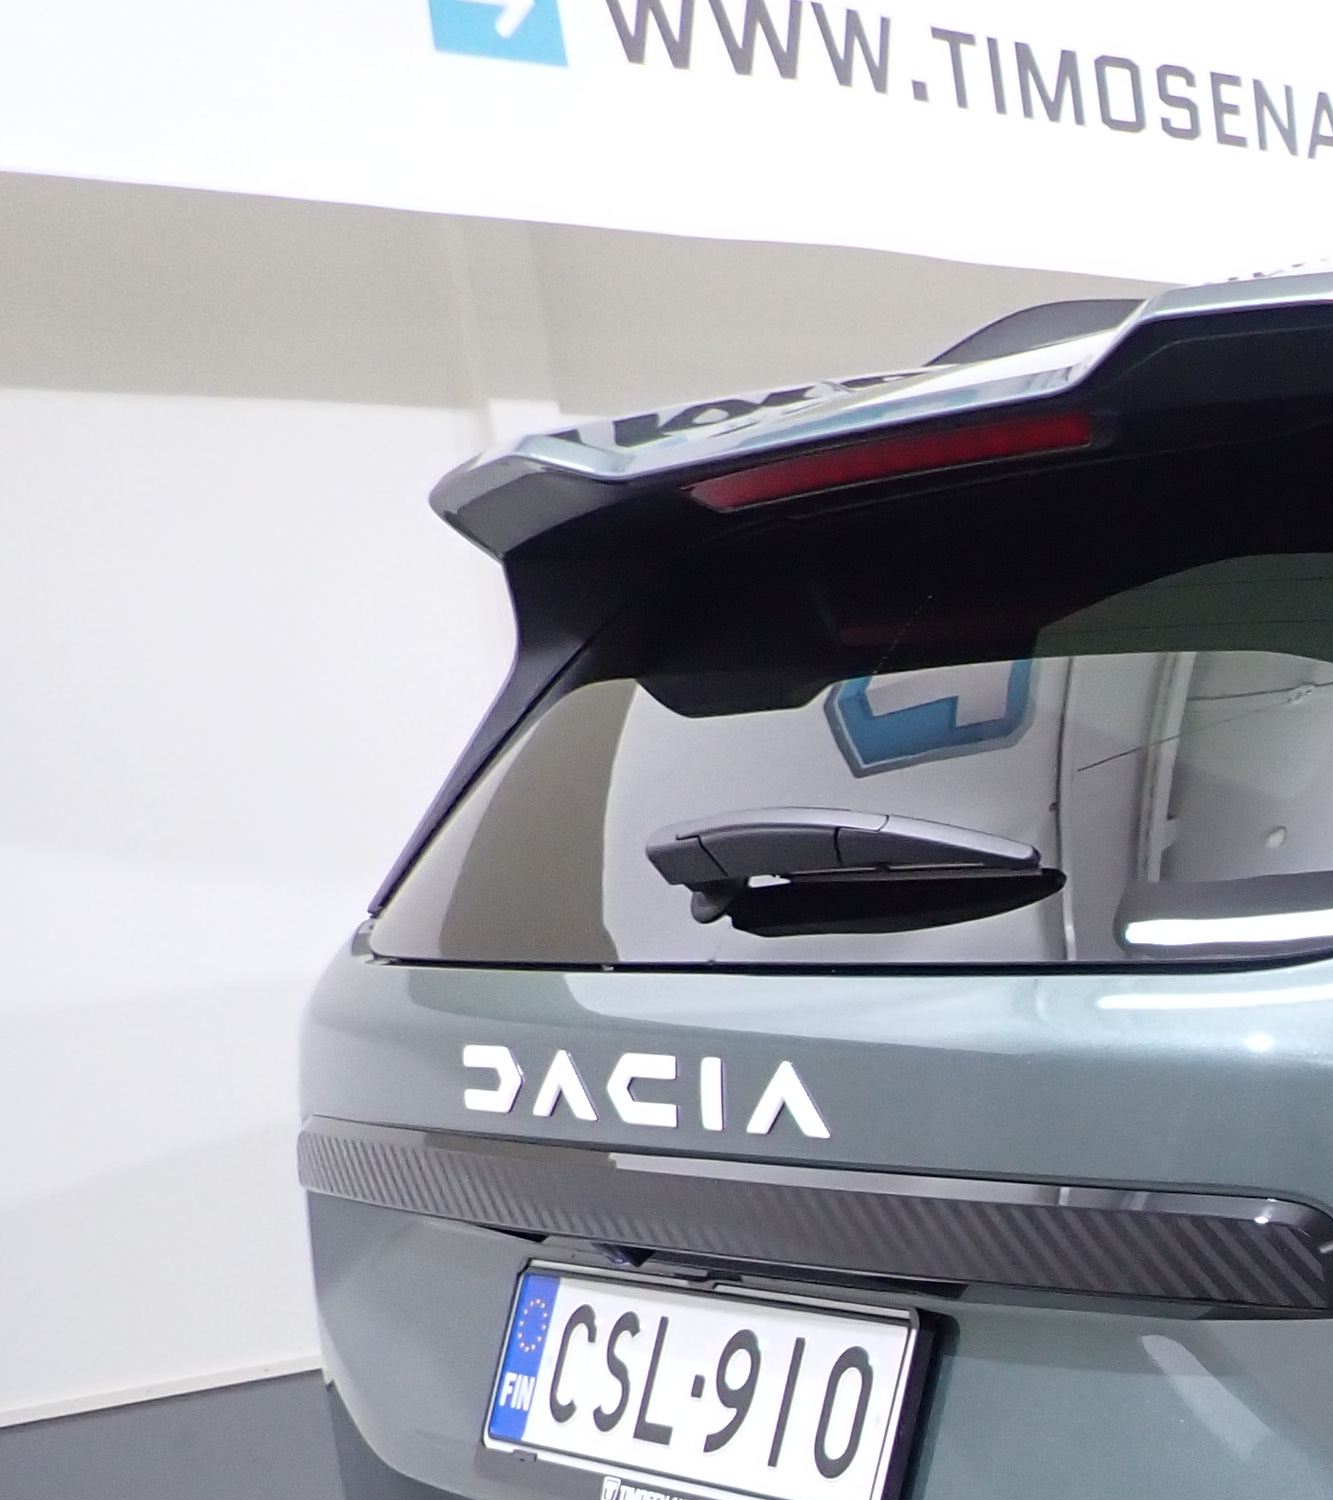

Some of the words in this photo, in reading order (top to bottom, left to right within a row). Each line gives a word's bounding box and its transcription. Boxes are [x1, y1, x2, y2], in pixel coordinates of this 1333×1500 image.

[463, 1044, 831, 1139] DACIA
[500, 1372, 536, 1411] FIN
[549, 1304, 874, 1479] CSL-910
